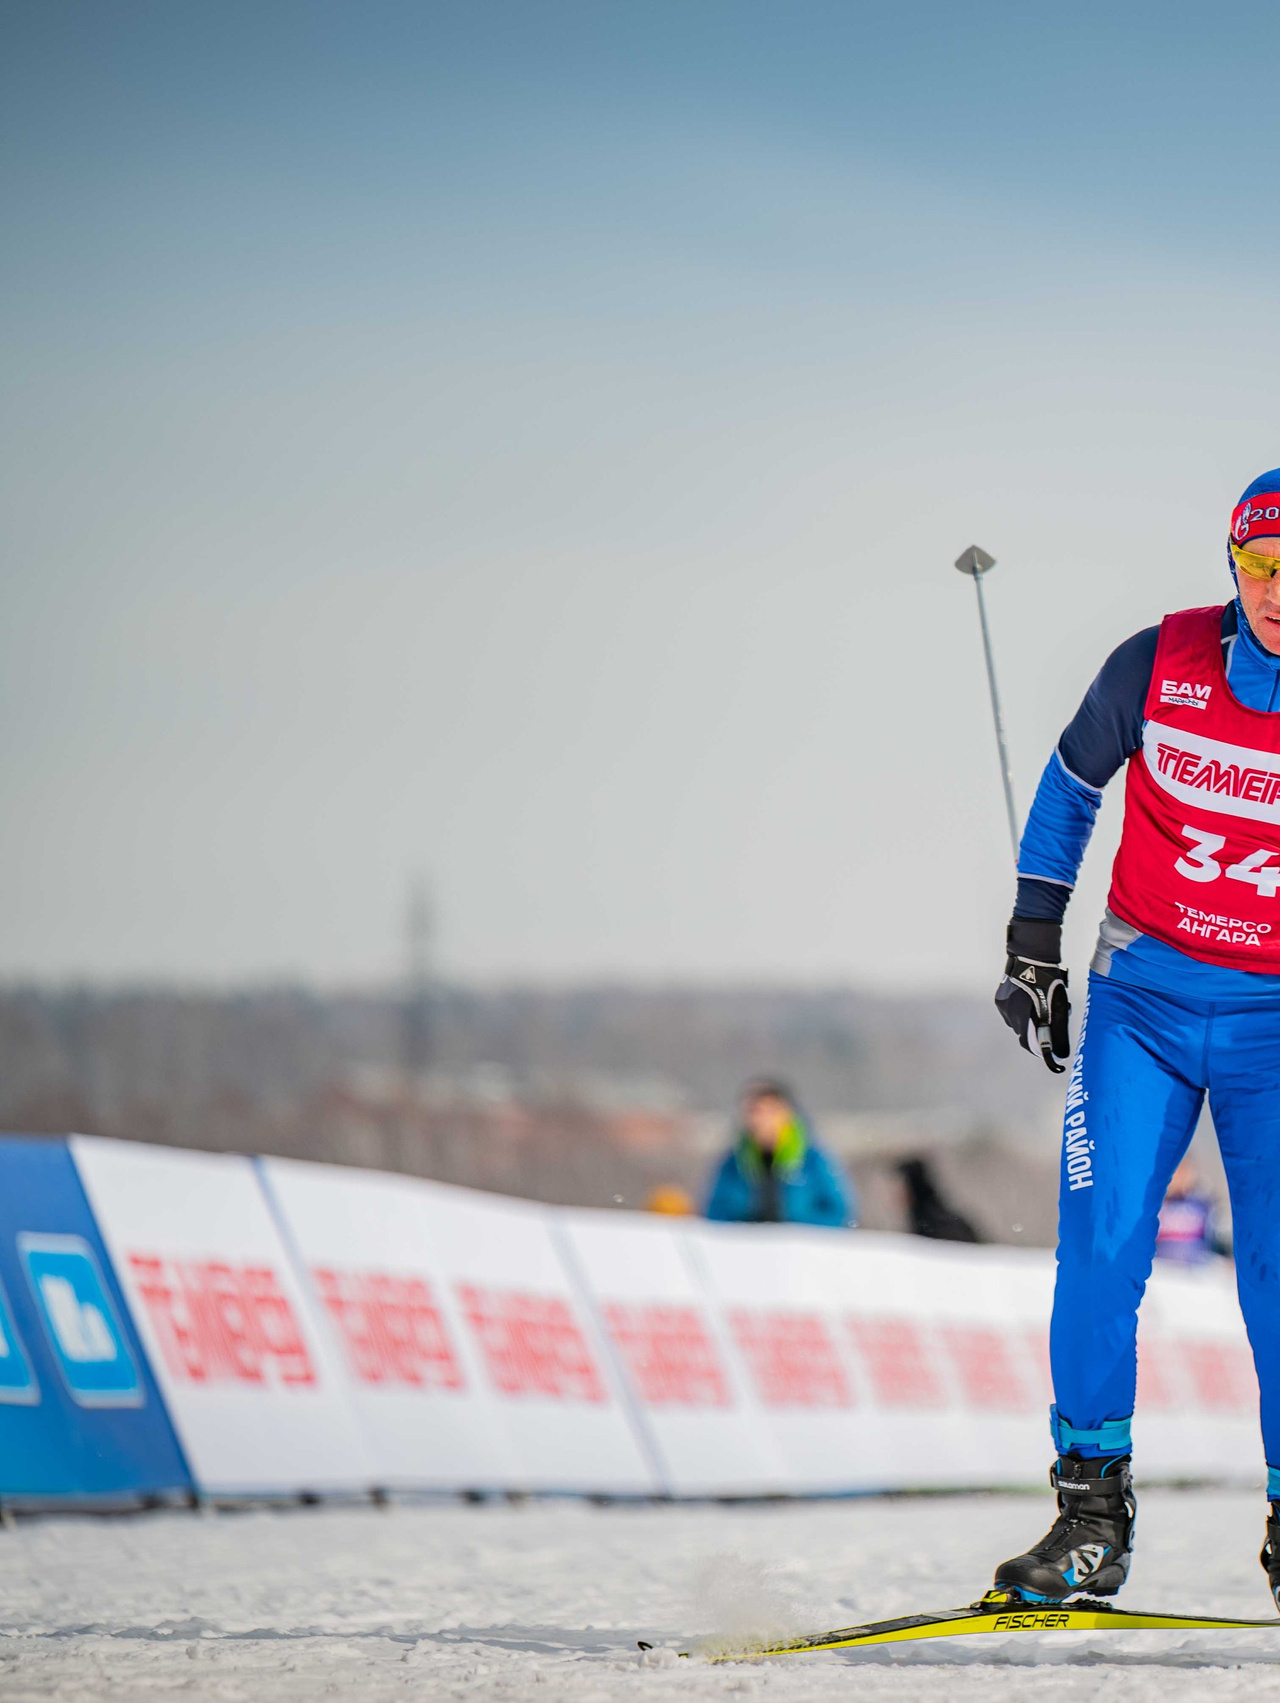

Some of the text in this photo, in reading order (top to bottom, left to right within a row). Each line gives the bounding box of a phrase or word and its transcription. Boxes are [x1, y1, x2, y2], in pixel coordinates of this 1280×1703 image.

[1161, 680, 1212, 699] БАМ
[1174, 901, 1272, 934] ТЕМЕРСО
[1177, 917, 1261, 946] АНГАРА
[1065, 1110, 1095, 1191] РАЙОН
[993, 1614, 1070, 1630] FISCHER
